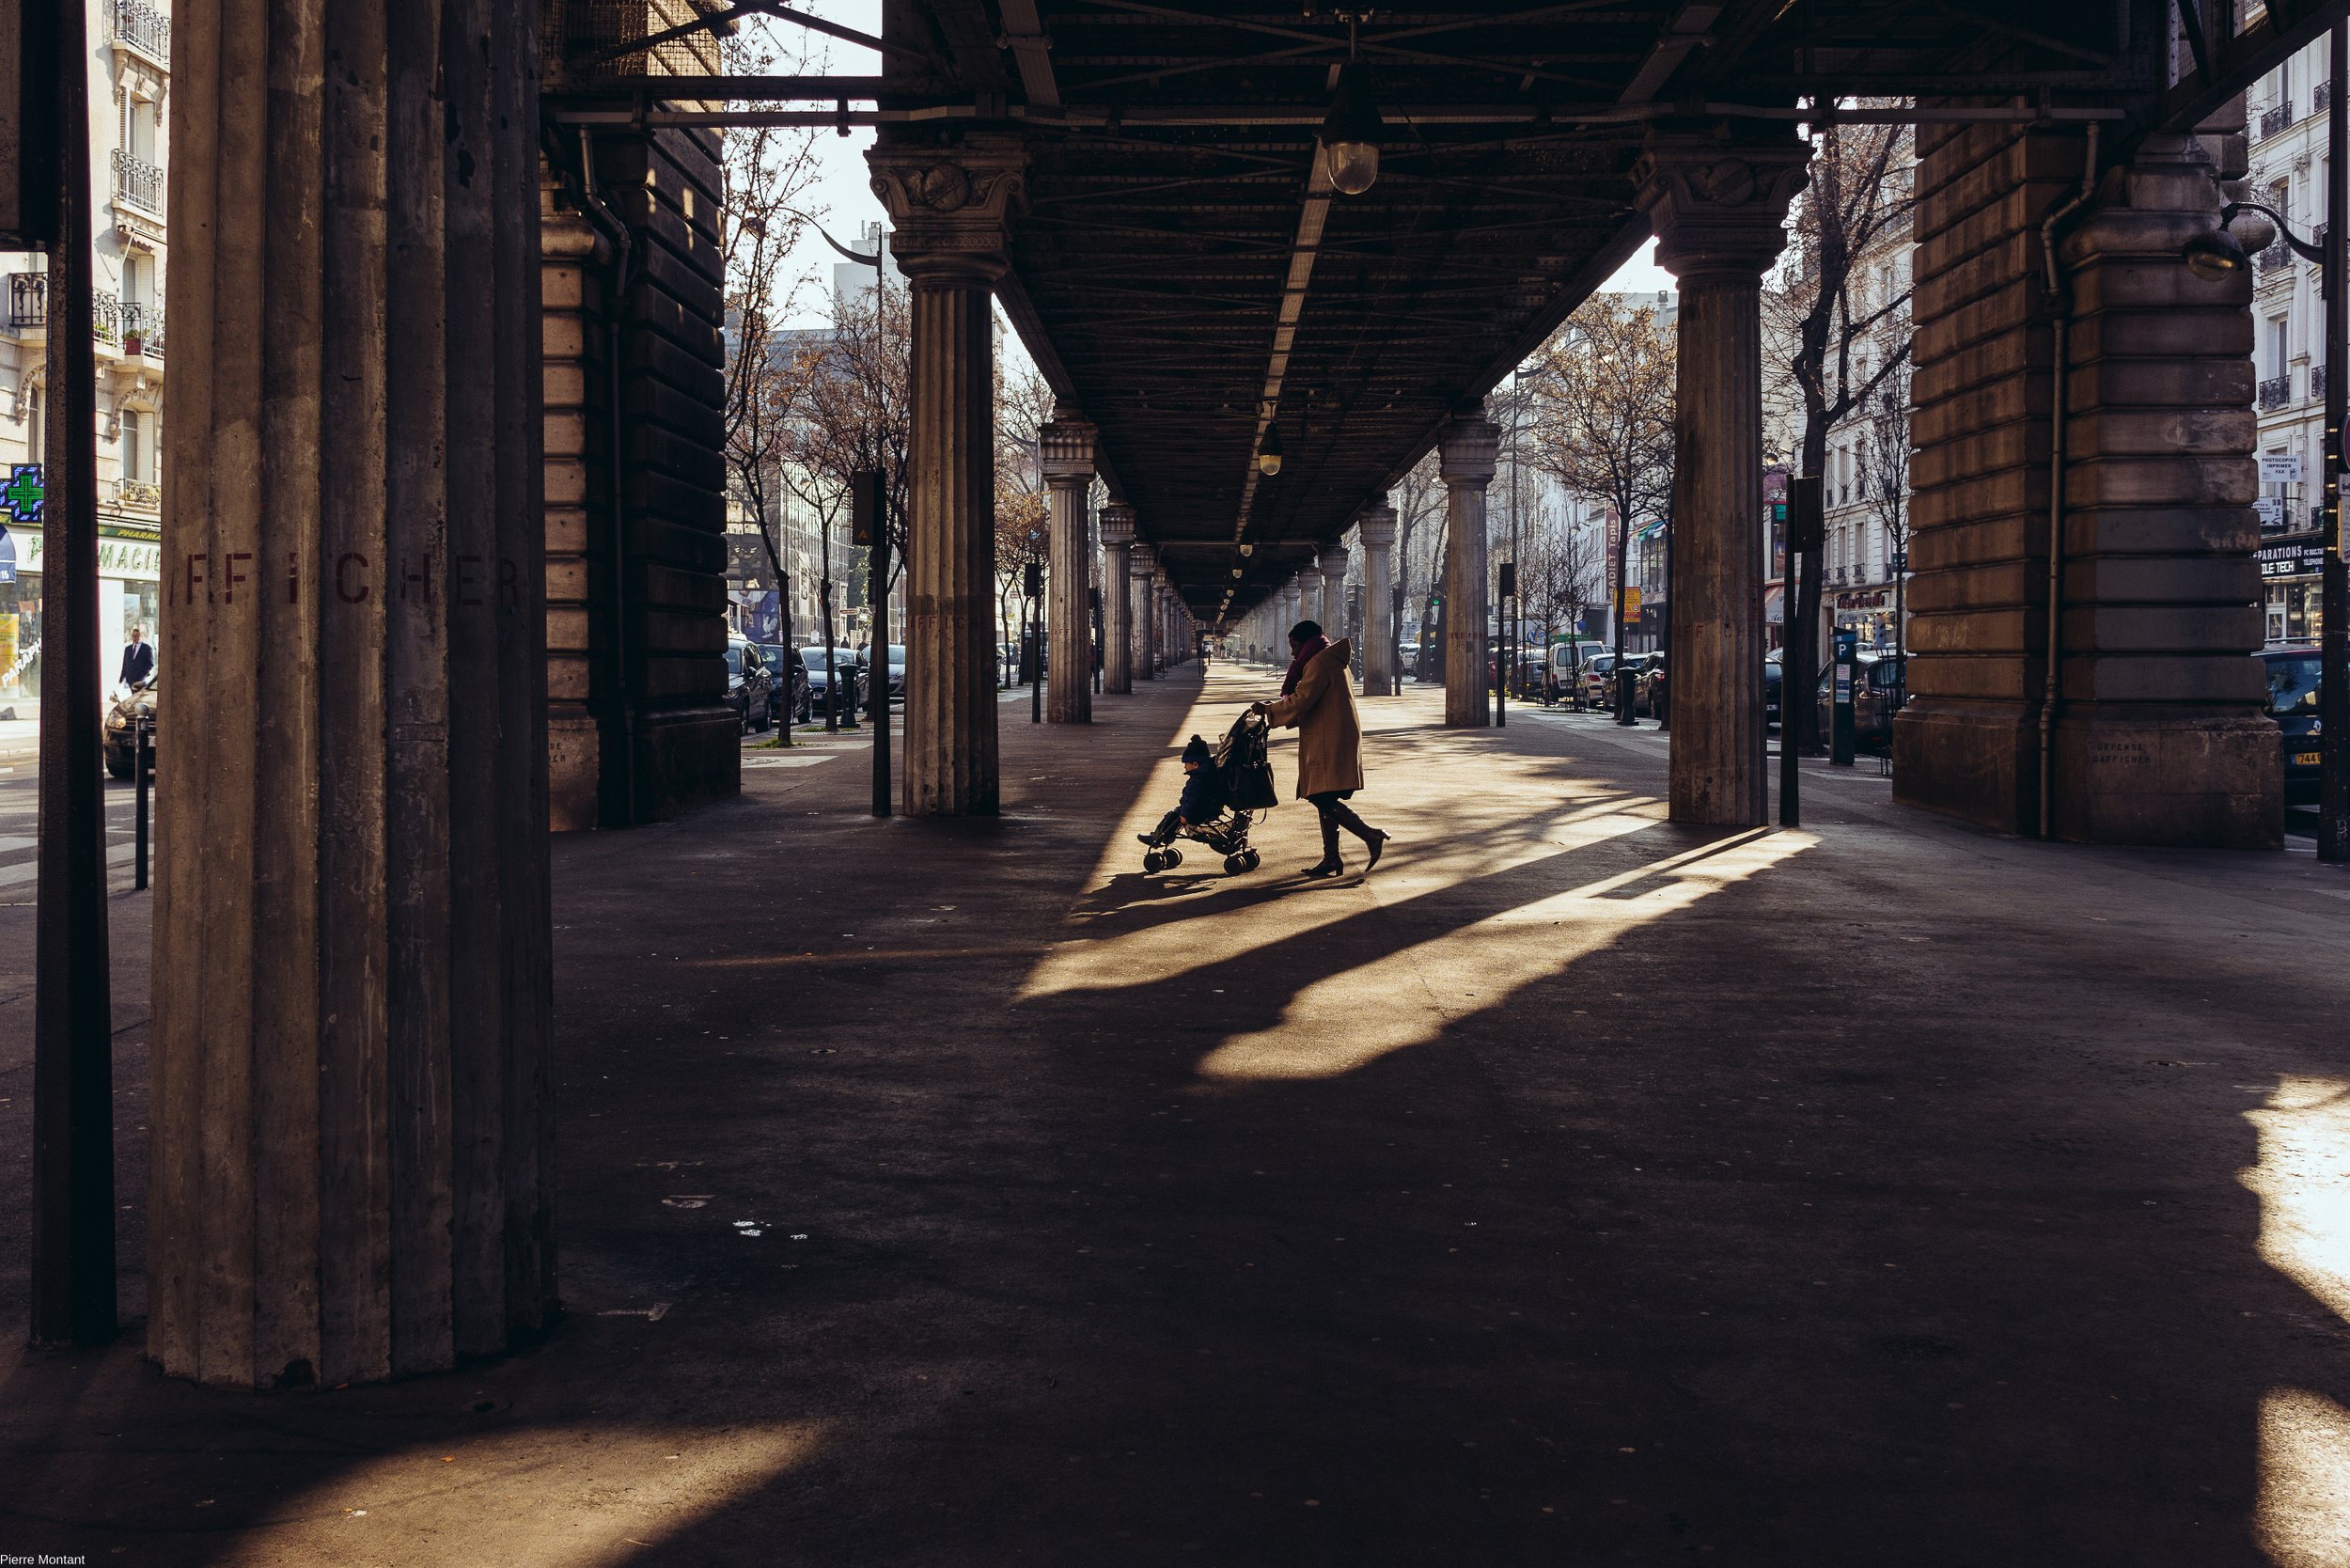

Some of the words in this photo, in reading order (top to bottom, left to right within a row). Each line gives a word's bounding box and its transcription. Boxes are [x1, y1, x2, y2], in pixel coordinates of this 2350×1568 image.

[1608, 519, 1617, 548] Tapis
[2276, 560, 2295, 573] TECH
[1839, 644, 1847, 656] P
